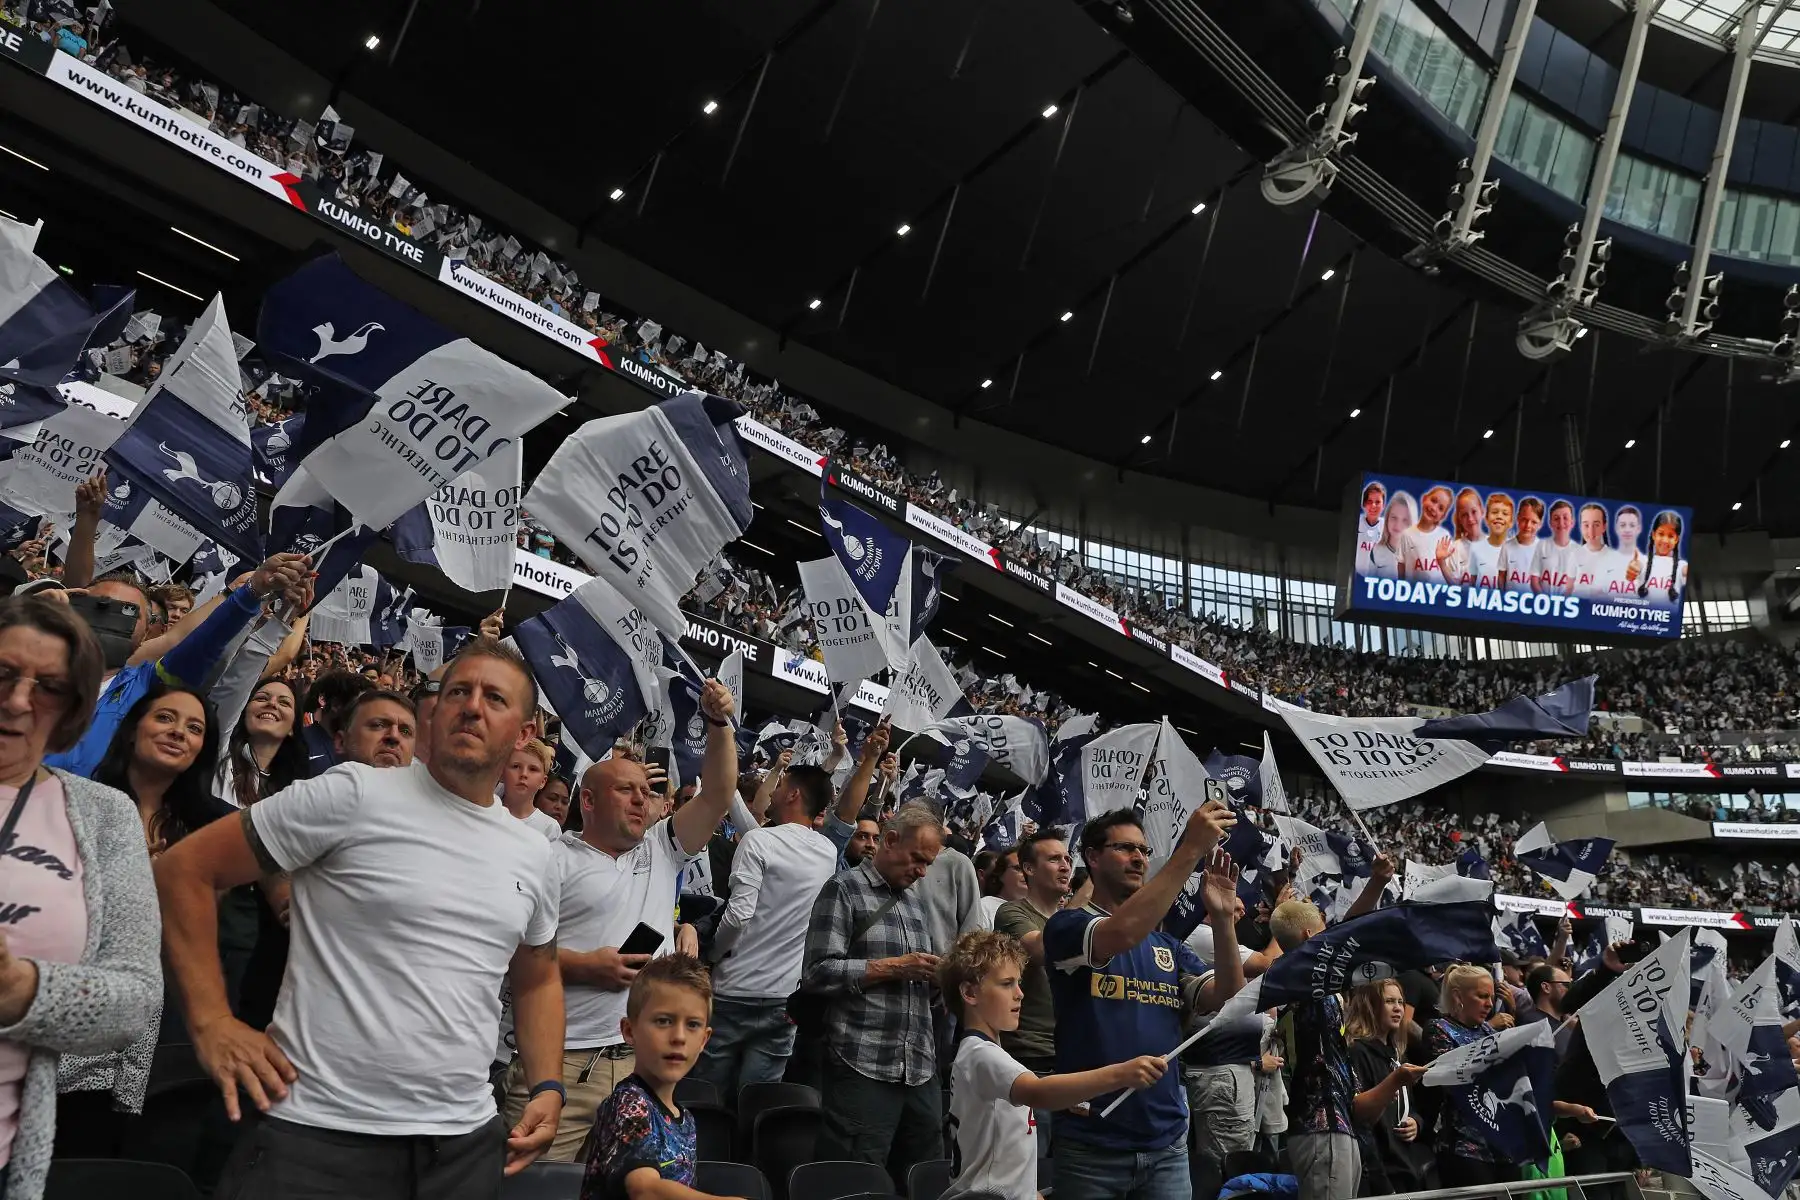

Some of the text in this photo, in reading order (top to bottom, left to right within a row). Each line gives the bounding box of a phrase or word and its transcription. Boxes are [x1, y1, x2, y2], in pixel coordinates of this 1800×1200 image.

[68, 68, 263, 179] www.kumhotire.com
[317, 197, 424, 263] KUMHO TYRE
[452, 270, 582, 346] www.kumhotire.com
[620, 356, 666, 390] KUMHO
[585, 440, 669, 552] TO DARE
[840, 472, 897, 511] KUMHO TYRE
[609, 540, 639, 574] IS
[640, 466, 681, 509] DO
[912, 512, 985, 556] www.kumhotire.com
[854, 536, 874, 577] TOTTENHAM
[864, 547, 883, 582] HOTSPUR
[1006, 561, 1050, 591] KUMHO TYRE
[1608, 580, 1637, 593] AIA
[350, 586, 369, 599] ARE
[1364, 577, 1462, 608] TODAY'S
[1467, 587, 1580, 618] MASCOTS
[808, 600, 831, 618] TO
[1591, 603, 1670, 622] KUMHO TYRE
[830, 618, 858, 633] TO
[1132, 627, 1167, 652] KUMHO TYRE
[721, 635, 758, 661] TYRE
[1310, 733, 1349, 750] TO
[1323, 741, 1435, 766] IS TO DO
[1569, 761, 1616, 772] KUMHO TYRE
[1723, 766, 1778, 775] KUMHO TYRE
[1633, 985, 1658, 1013] TO
